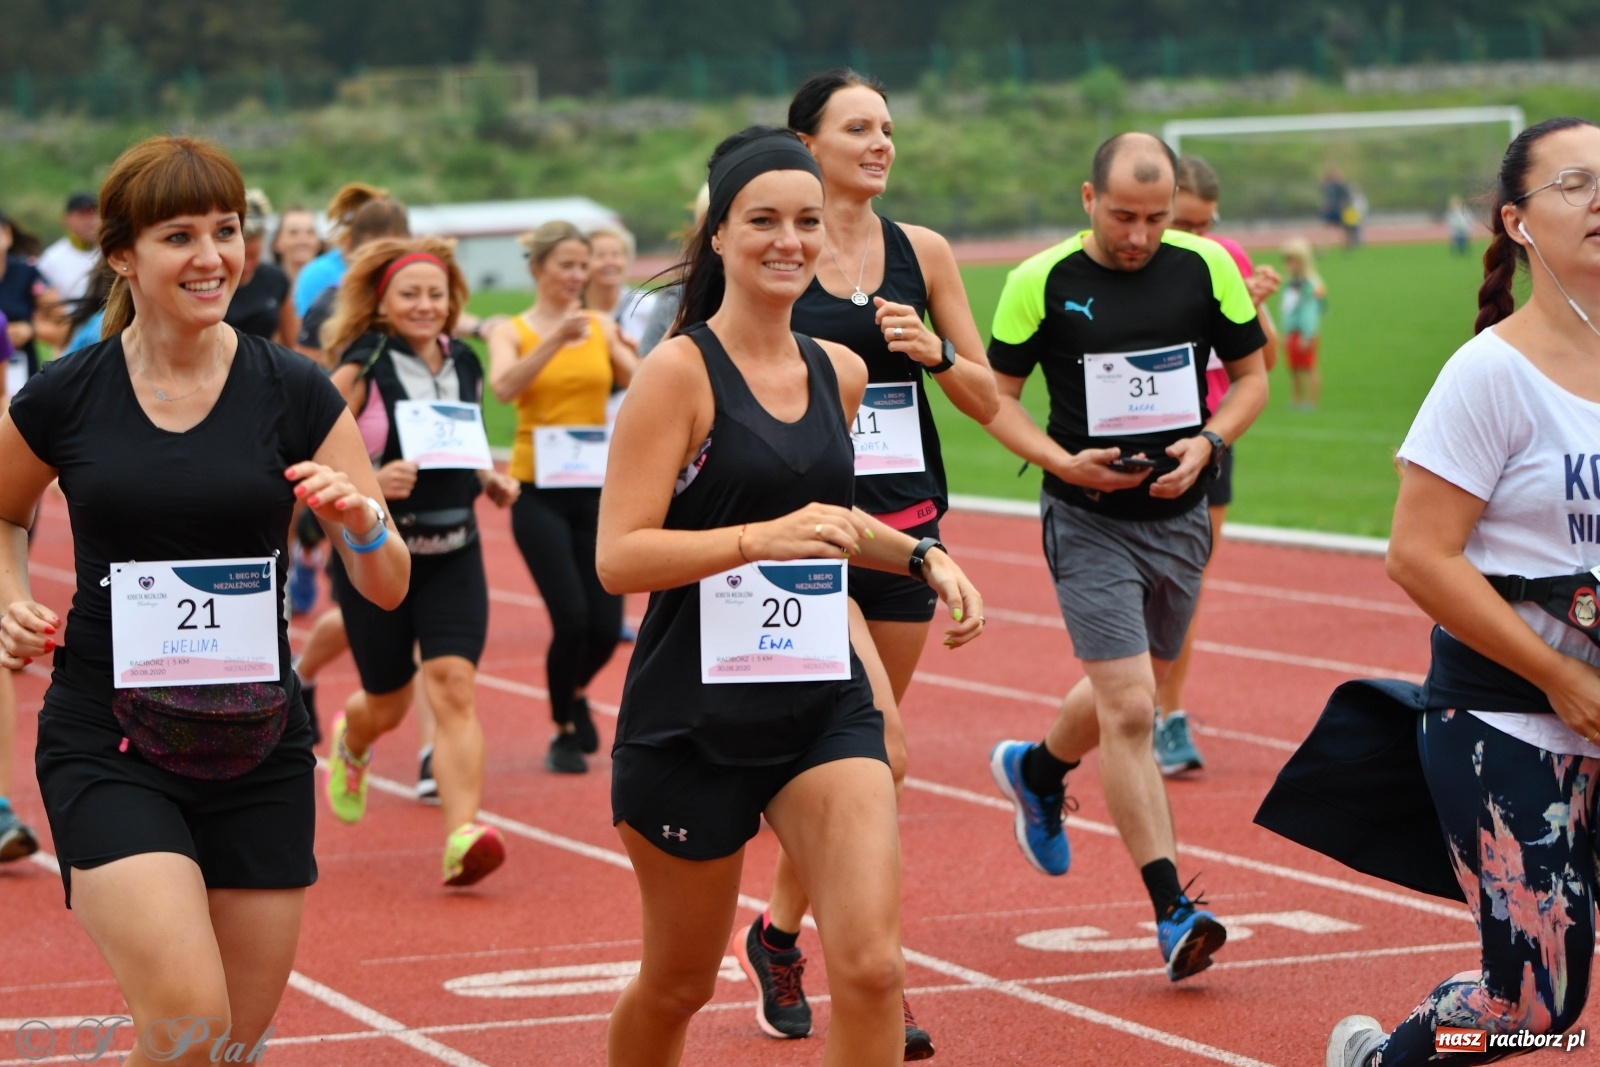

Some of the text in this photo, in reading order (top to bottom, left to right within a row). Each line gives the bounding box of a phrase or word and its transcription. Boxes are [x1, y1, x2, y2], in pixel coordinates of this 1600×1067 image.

[1129, 375, 1159, 398] 31
[434, 421, 456, 438] 37
[855, 411, 881, 434] 11
[854, 441, 889, 451] ENATA
[236, 572, 250, 580] BIEG
[177, 598, 220, 630] 21
[762, 598, 801, 628] 20
[162, 638, 219, 654] EWELINA
[758, 634, 794, 650] EWA
